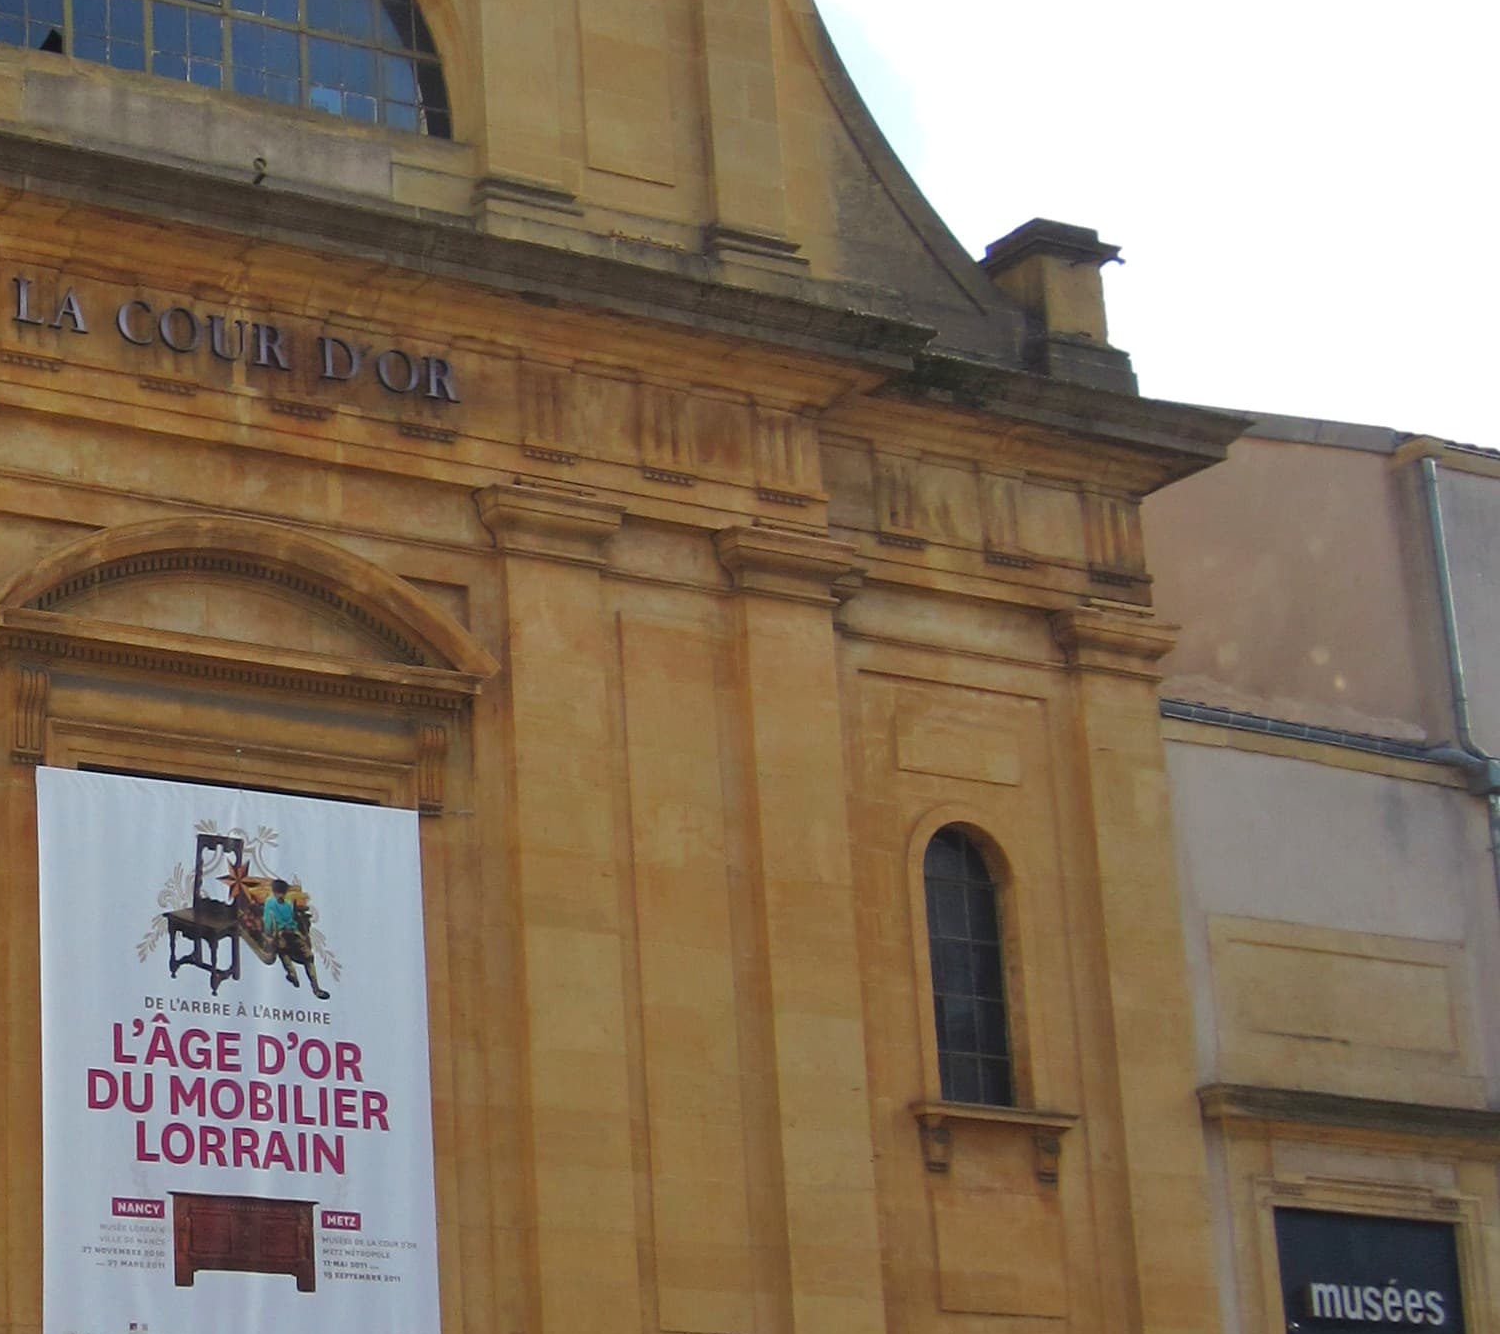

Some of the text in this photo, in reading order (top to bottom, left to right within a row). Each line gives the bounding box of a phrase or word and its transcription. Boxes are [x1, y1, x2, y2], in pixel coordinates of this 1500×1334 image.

[11, 276, 461, 404] LA COUR D'OR
[144, 995, 332, 1026] DE L'ARBRE À L'ARMOIRE
[112, 1012, 364, 1084] L'ÂGE D'OR
[86, 1067, 391, 1132] DU MOBILIER
[135, 1119, 346, 1176] LORRAIN
[117, 1202, 161, 1215] NANCY
[326, 1215, 357, 1227] METZ
[1311, 1278, 1445, 1326] musées
